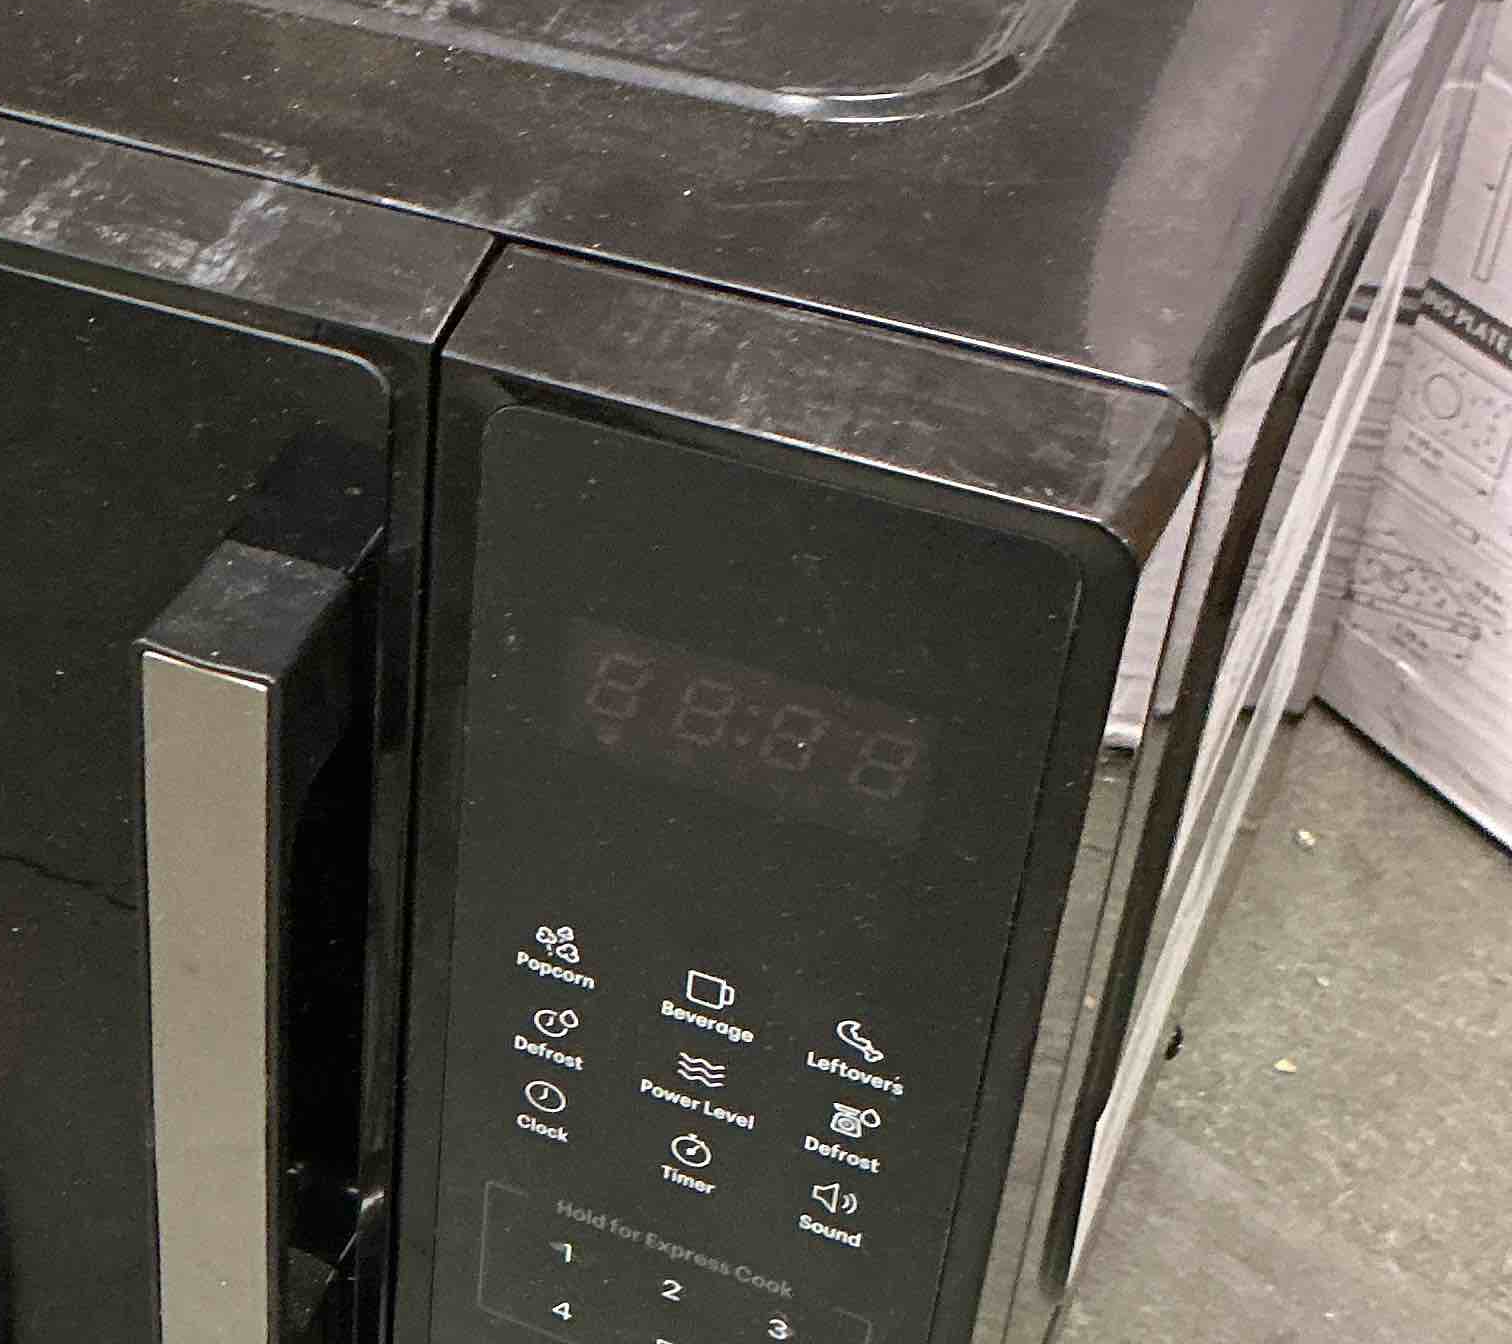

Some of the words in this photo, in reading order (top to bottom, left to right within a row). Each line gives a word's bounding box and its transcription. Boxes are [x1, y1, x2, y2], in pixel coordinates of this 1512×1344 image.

[516, 951, 595, 990] Popcorn
[661, 1000, 754, 1043] Beverage
[514, 1035, 584, 1071] Defrost
[806, 1051, 904, 1096] Leftovers
[640, 1078, 701, 1112] Power
[703, 1100, 755, 1130] Level
[516, 1114, 569, 1143] Clock
[804, 1135, 881, 1174] Defrost
[661, 1164, 716, 1194] Timer
[798, 1214, 862, 1248] Sound
[556, 1199, 607, 1230] Hold
[609, 1217, 641, 1243] for
[645, 1232, 731, 1276] Express
[734, 1265, 794, 1299] Cook
[560, 1242, 574, 1263] 1
[661, 1279, 683, 1302] 2
[551, 1301, 573, 1321] 4
[767, 1318, 790, 1340] 3
